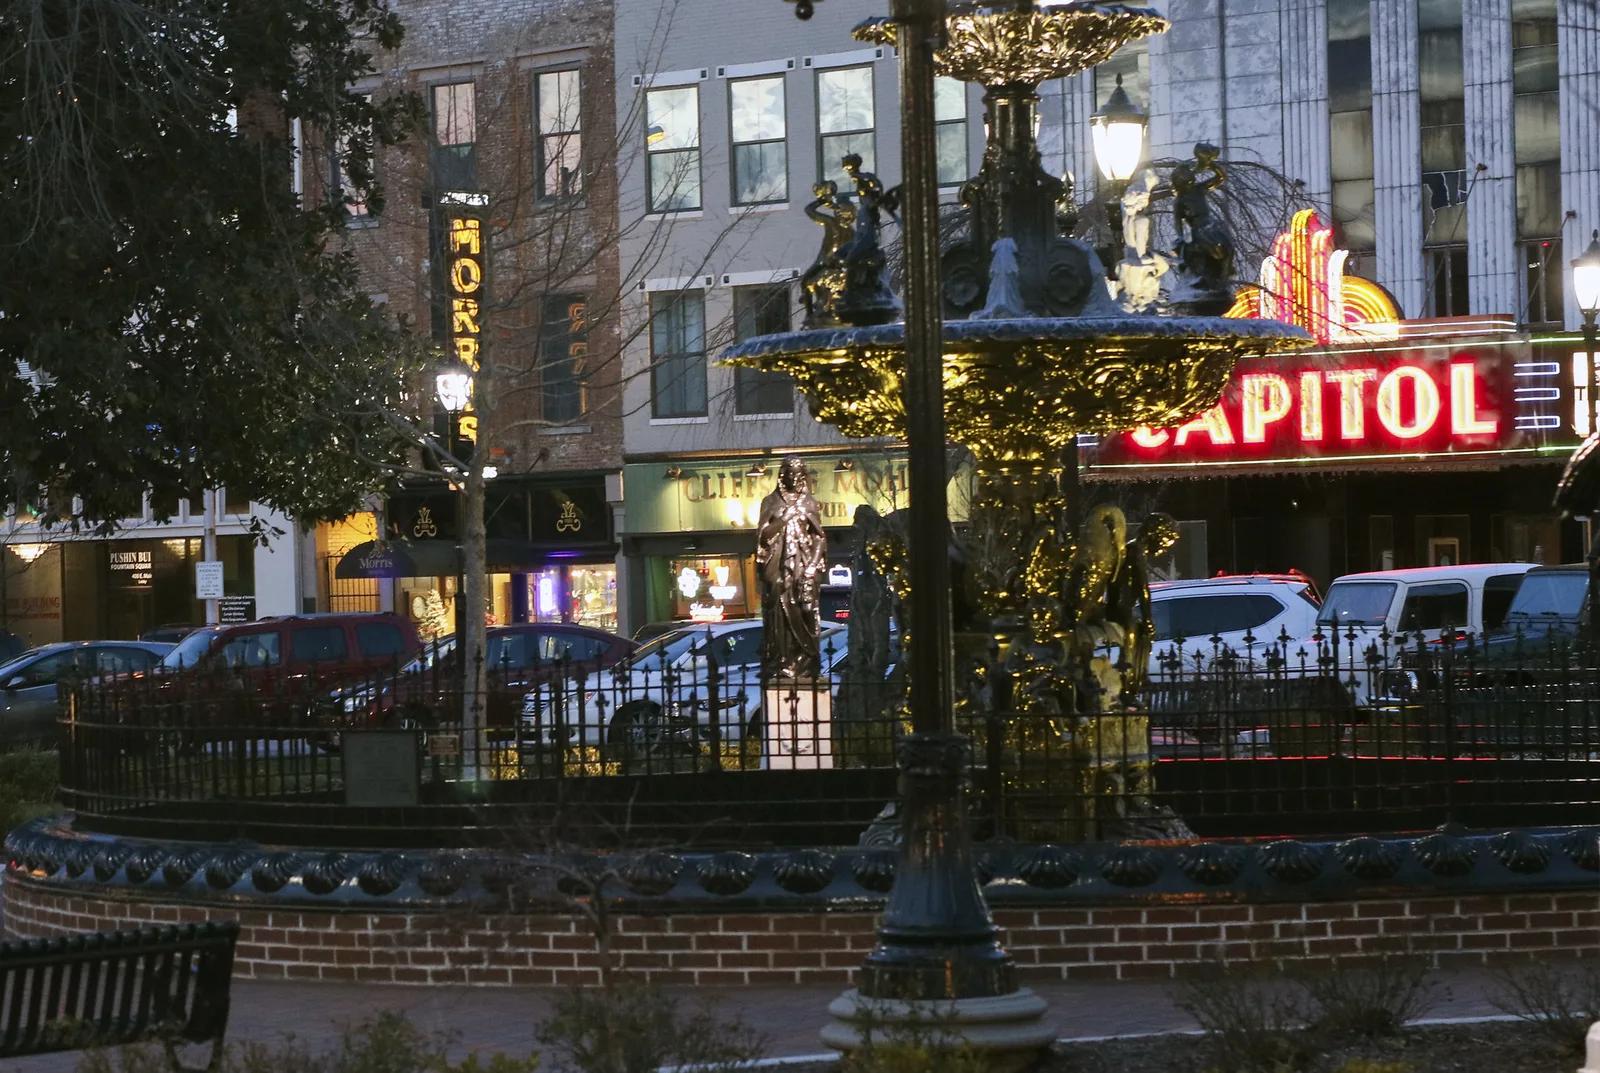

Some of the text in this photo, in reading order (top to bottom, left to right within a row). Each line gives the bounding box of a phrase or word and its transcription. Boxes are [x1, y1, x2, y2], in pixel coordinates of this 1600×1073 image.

[1130, 362, 1498, 448] APITOL
[110, 552, 137, 563] PUSHIN
[358, 558, 393, 569] Morris
